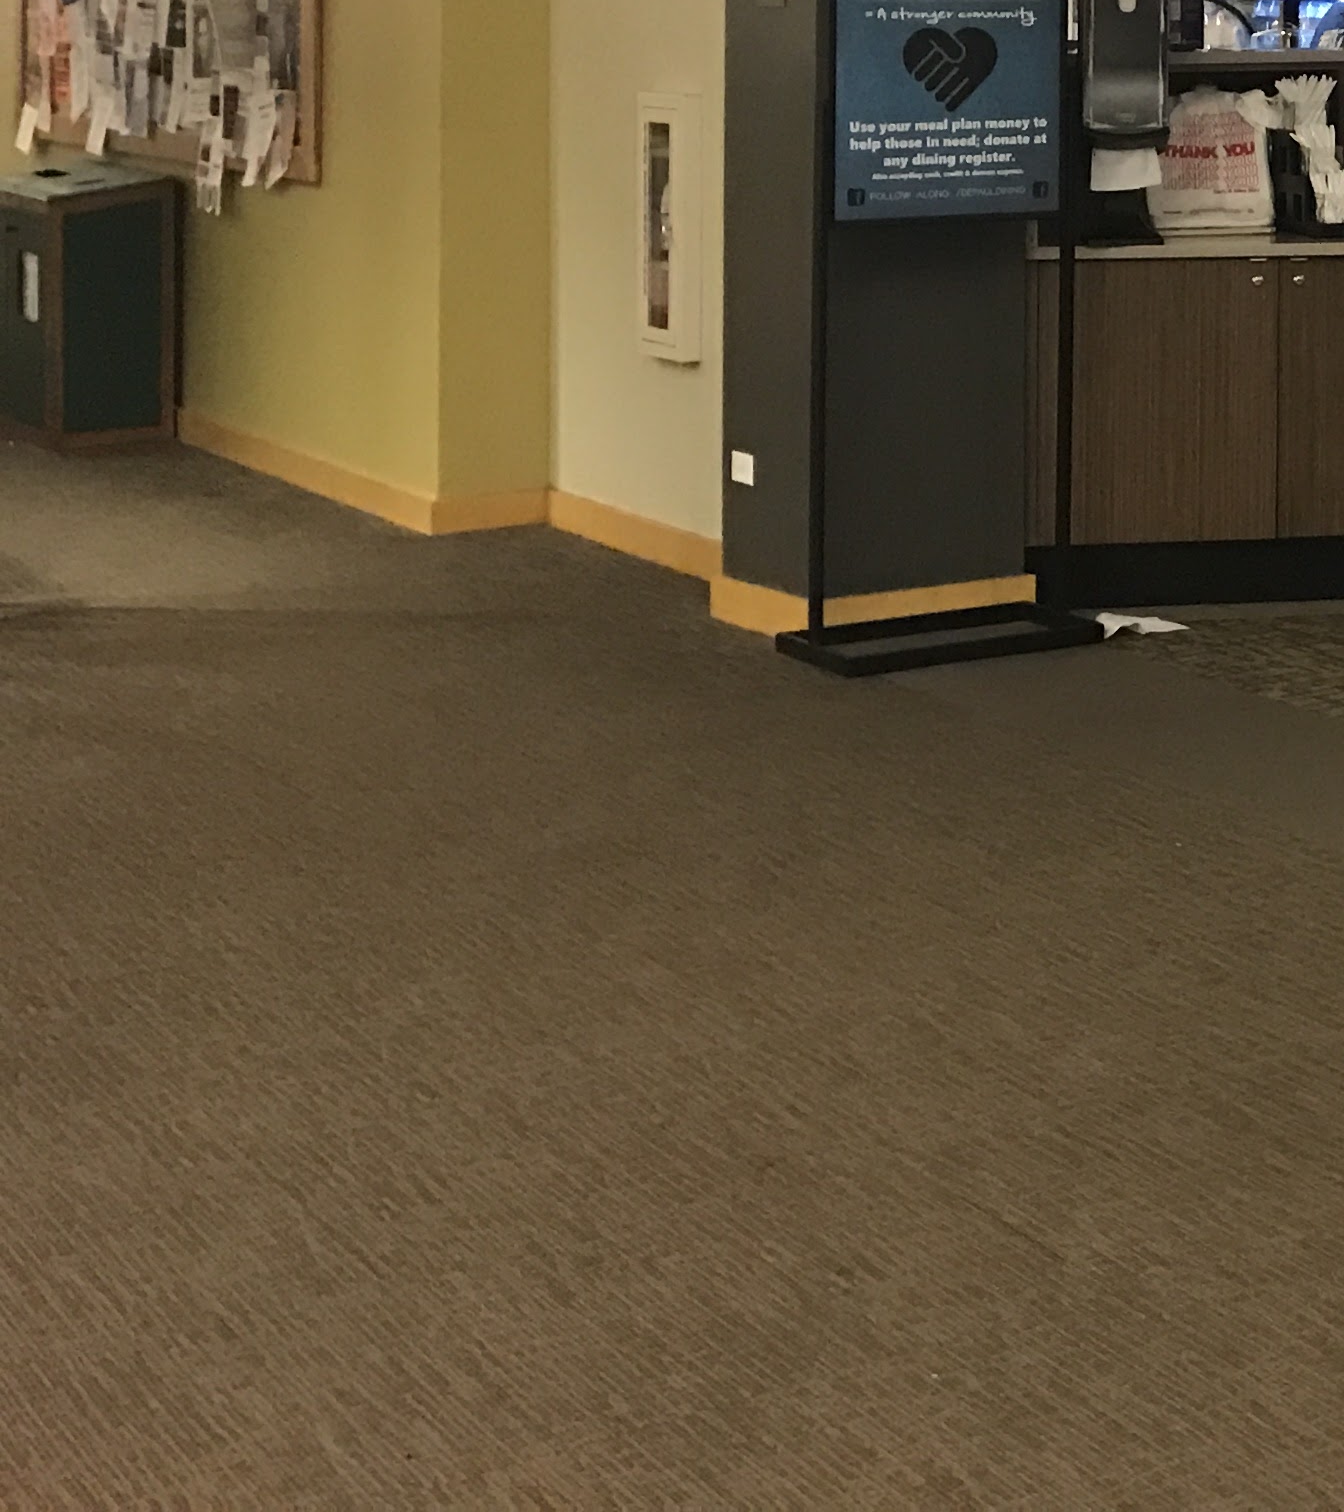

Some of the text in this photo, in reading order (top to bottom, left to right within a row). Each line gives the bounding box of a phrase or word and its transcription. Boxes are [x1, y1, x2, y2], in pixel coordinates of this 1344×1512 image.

[876, 7, 887, 21] A
[890, 7, 952, 25] stronger
[957, 6, 1038, 27] community
[849, 117, 1048, 135] Use your meal plan money to
[849, 138, 881, 152] help
[884, 137, 922, 149] those
[926, 136, 940, 148] in
[983, 134, 1030, 146] donate
[1033, 133, 1047, 144] at
[1165, 141, 1256, 159] THANK YOU
[883, 150, 1016, 169] any dining register.
